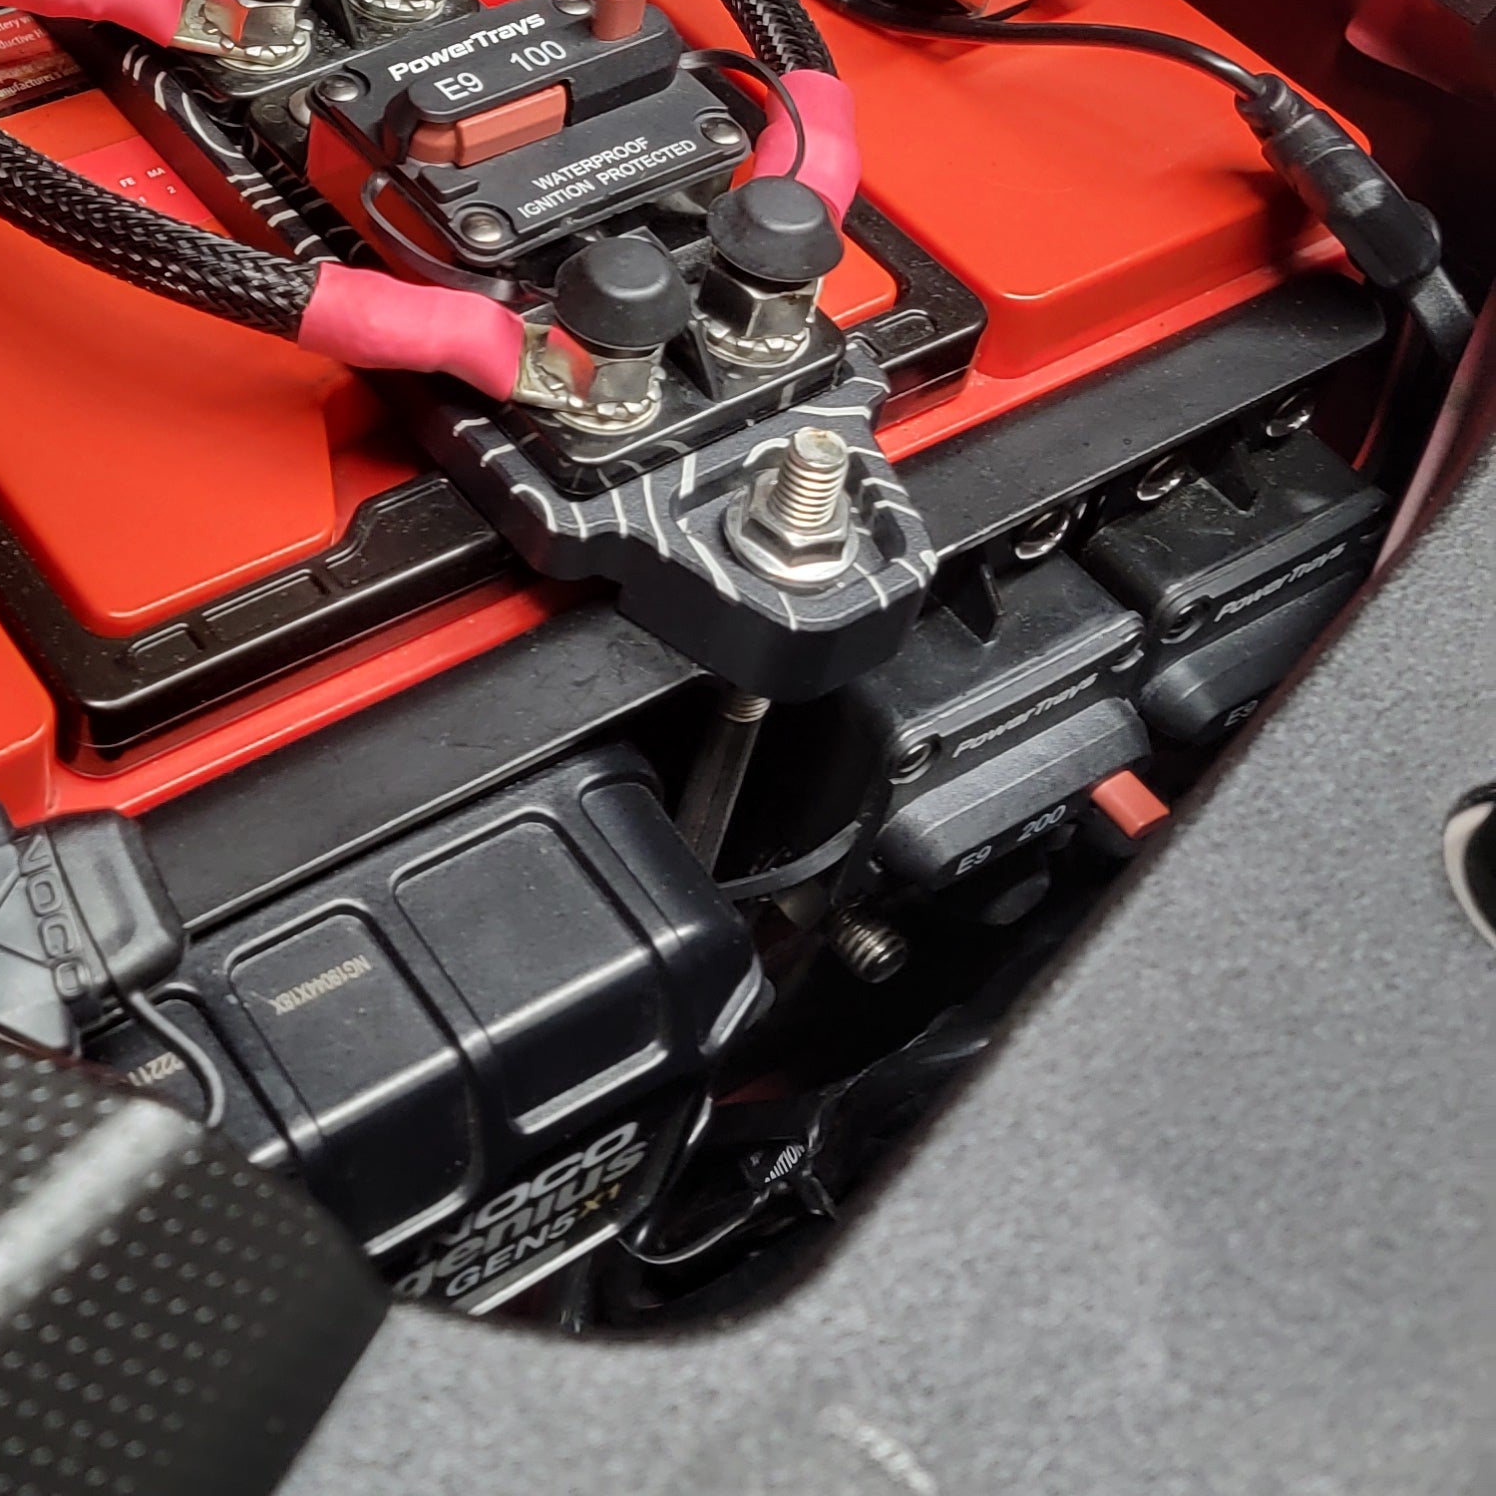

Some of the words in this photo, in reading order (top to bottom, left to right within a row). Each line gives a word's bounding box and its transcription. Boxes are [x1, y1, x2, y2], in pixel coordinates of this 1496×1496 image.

[387, 12, 546, 82] PowerTrays
[433, 71, 484, 102] E9
[509, 39, 568, 73] 100
[516, 179, 597, 220] IGNITION
[595, 139, 698, 187] PROTECTED
[531, 136, 650, 192] WATERPROOF
[1214, 542, 1347, 623] PowerTrays
[951, 672, 1100, 759] PowerTrays
[1223, 699, 1259, 728] E9
[954, 843, 993, 877] E9
[1017, 804, 1068, 843] 200
